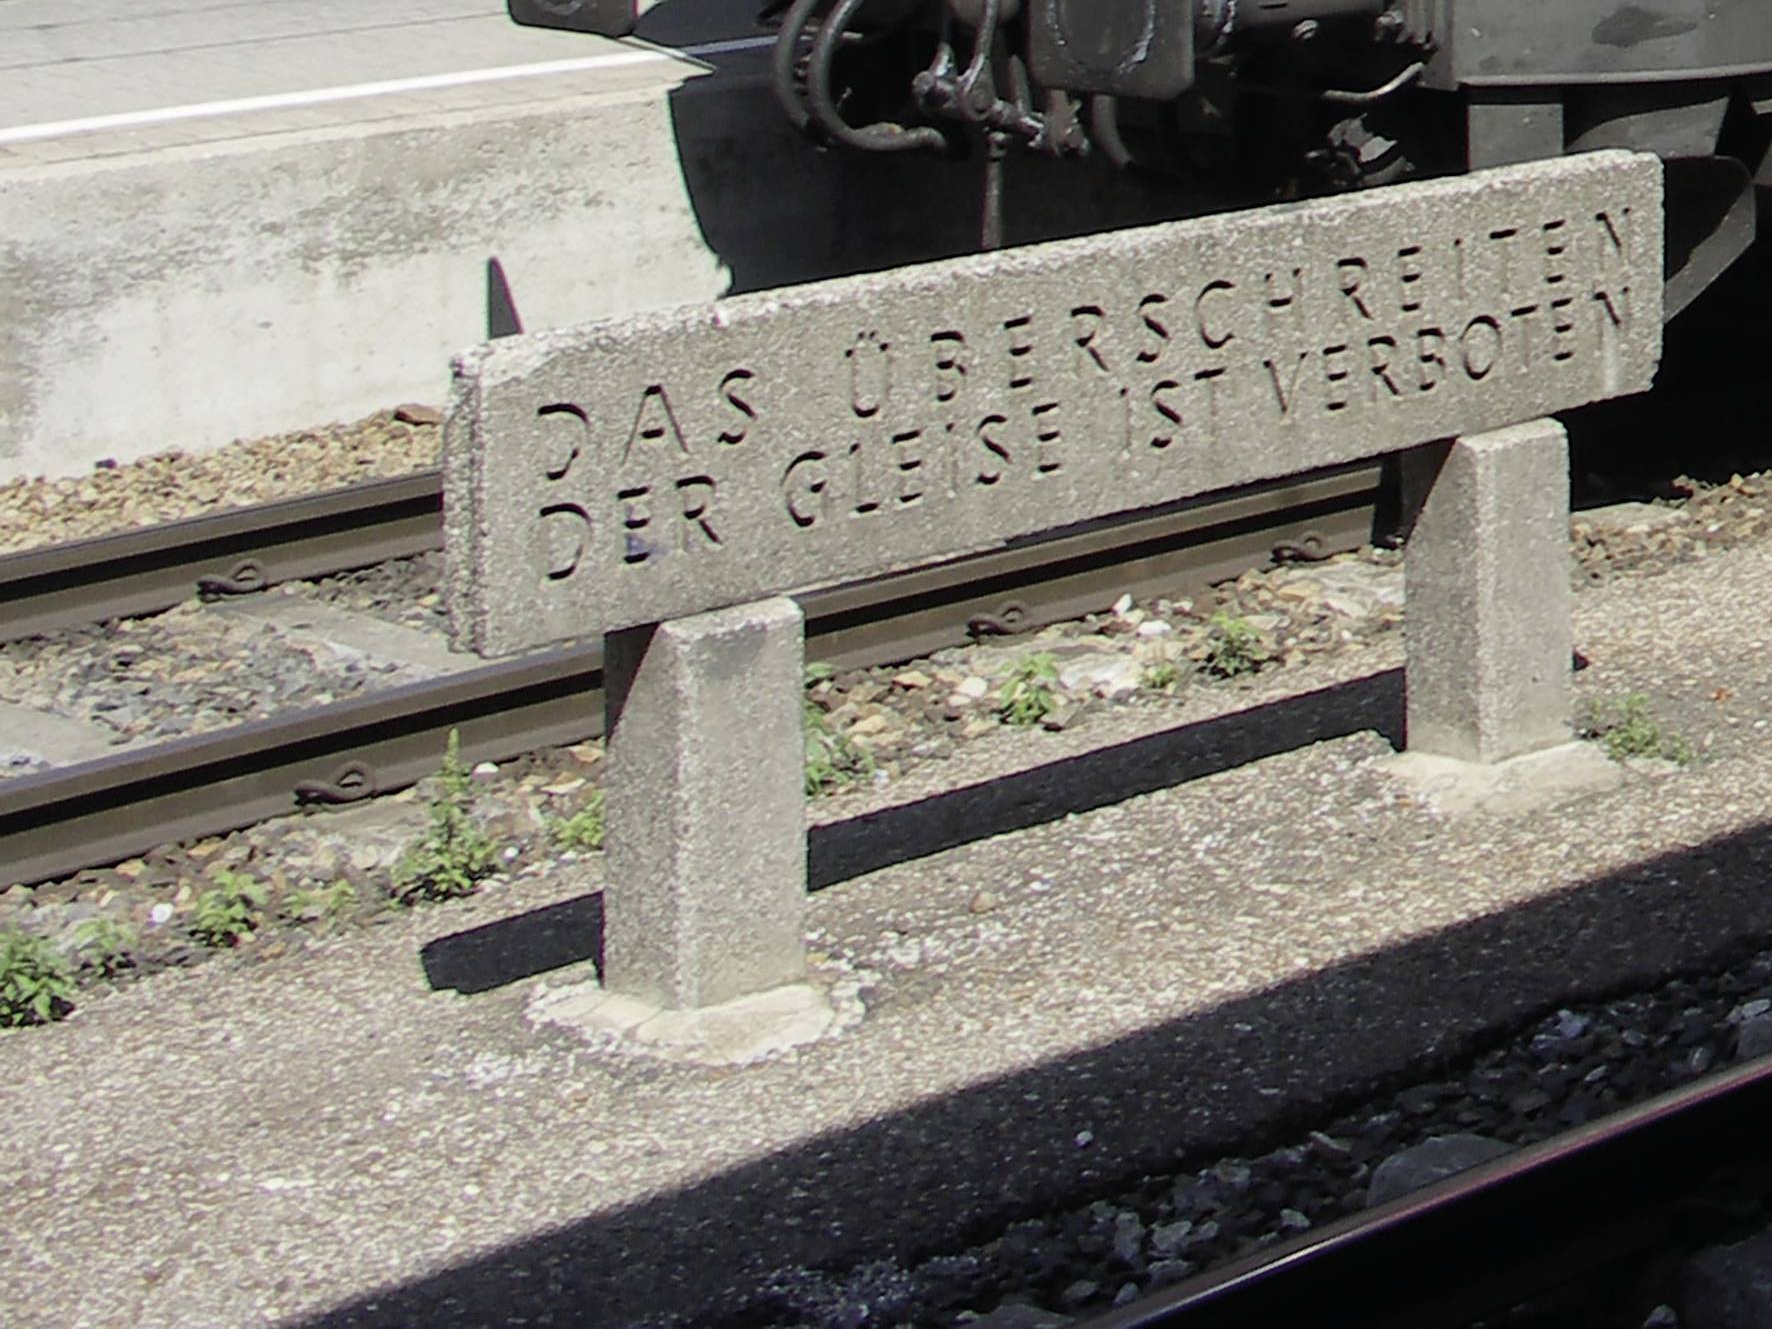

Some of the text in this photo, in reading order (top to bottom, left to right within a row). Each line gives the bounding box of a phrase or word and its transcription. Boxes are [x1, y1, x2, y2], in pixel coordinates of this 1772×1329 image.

[534, 286, 1632, 581] DER GLEISE IST VERBOTEN
[536, 207, 1632, 480] DAS ÜBERSCHREITEN
